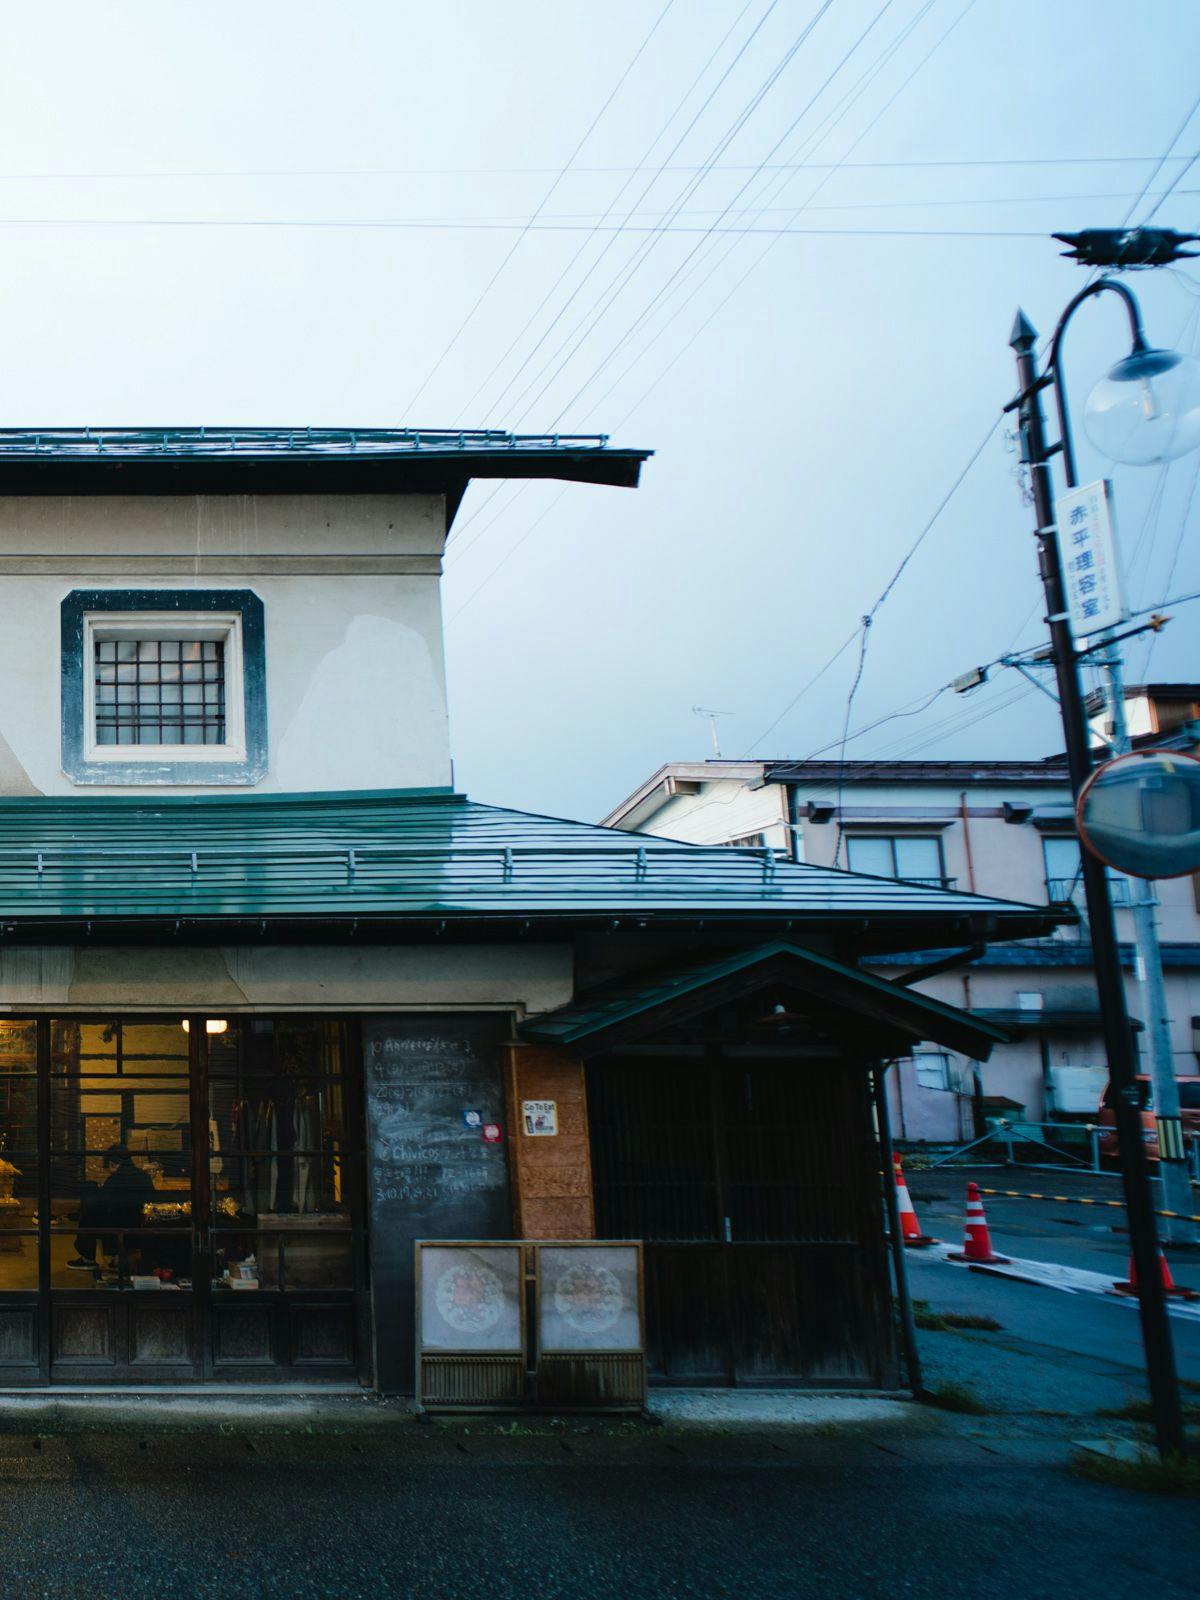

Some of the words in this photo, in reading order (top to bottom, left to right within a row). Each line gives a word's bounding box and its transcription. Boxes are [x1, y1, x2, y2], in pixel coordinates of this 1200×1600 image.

[1070, 505, 1100, 619] 赤平理容室
[524, 1103, 535, 1111] Go
[544, 1103, 555, 1111] Eat
